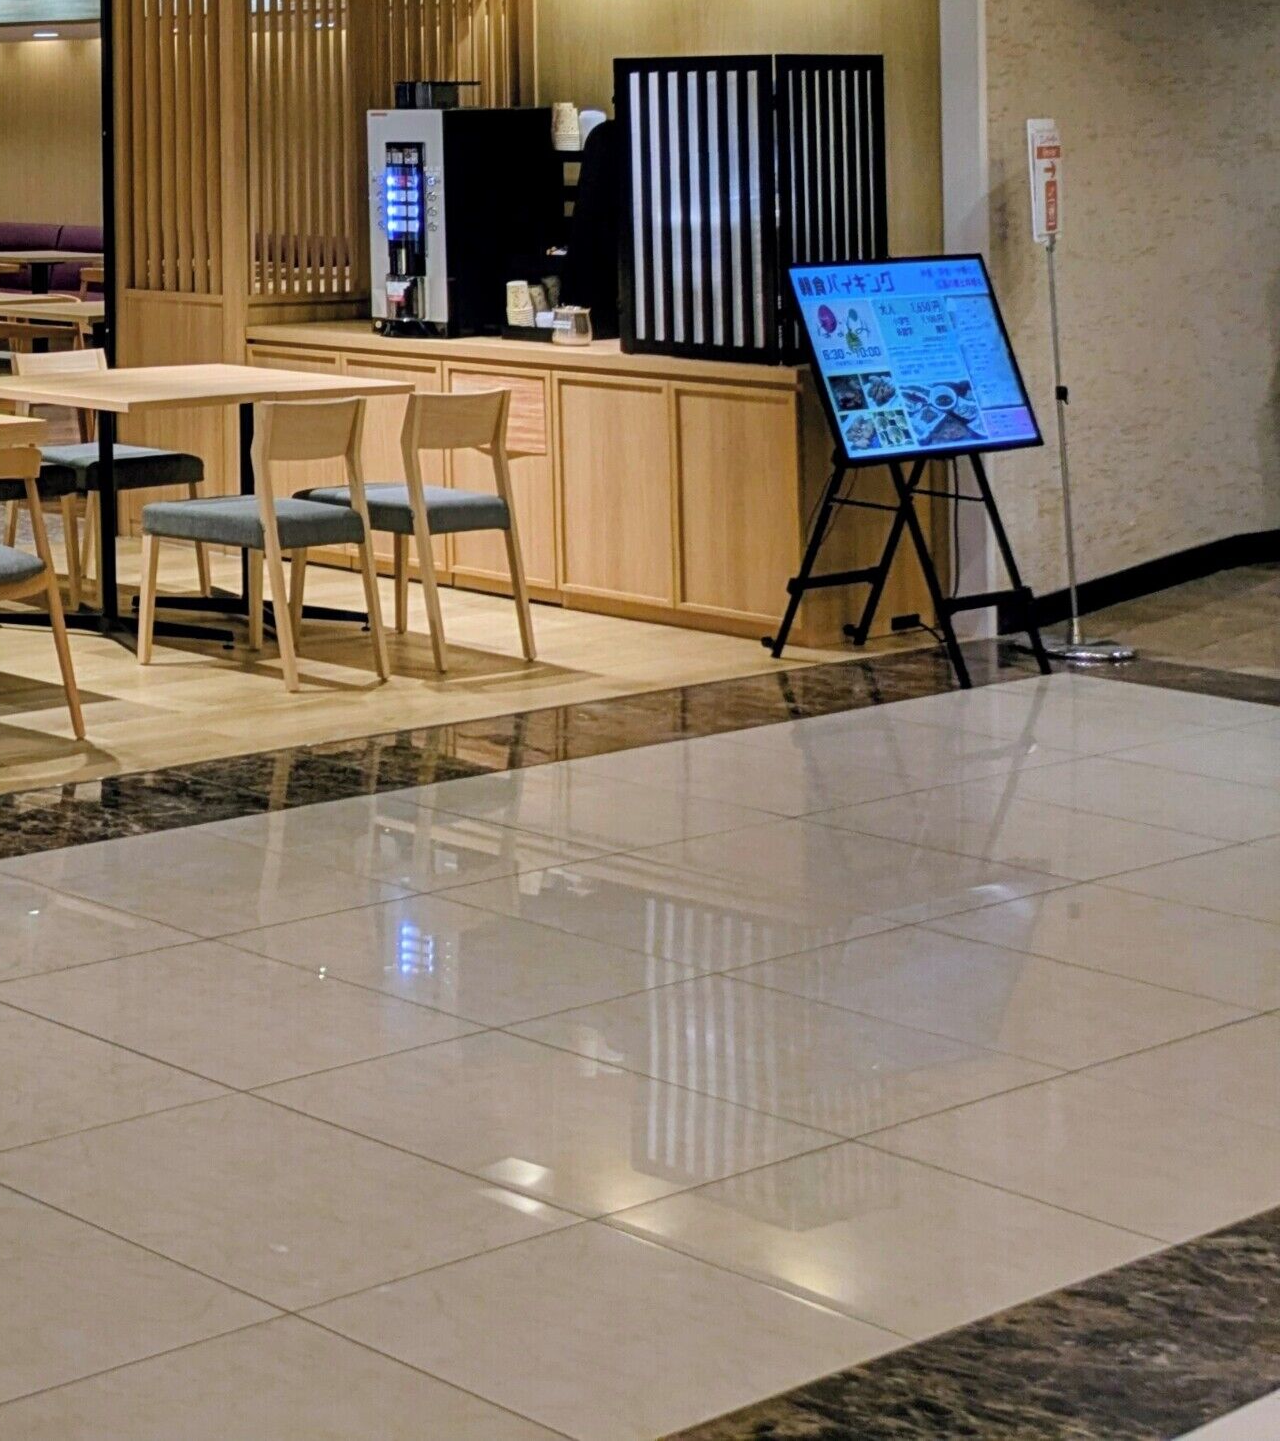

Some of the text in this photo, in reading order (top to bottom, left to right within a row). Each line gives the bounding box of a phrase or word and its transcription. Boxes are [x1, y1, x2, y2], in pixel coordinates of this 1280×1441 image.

[797, 269, 896, 297] 朝食バイキング
[879, 304, 895, 315] 大人
